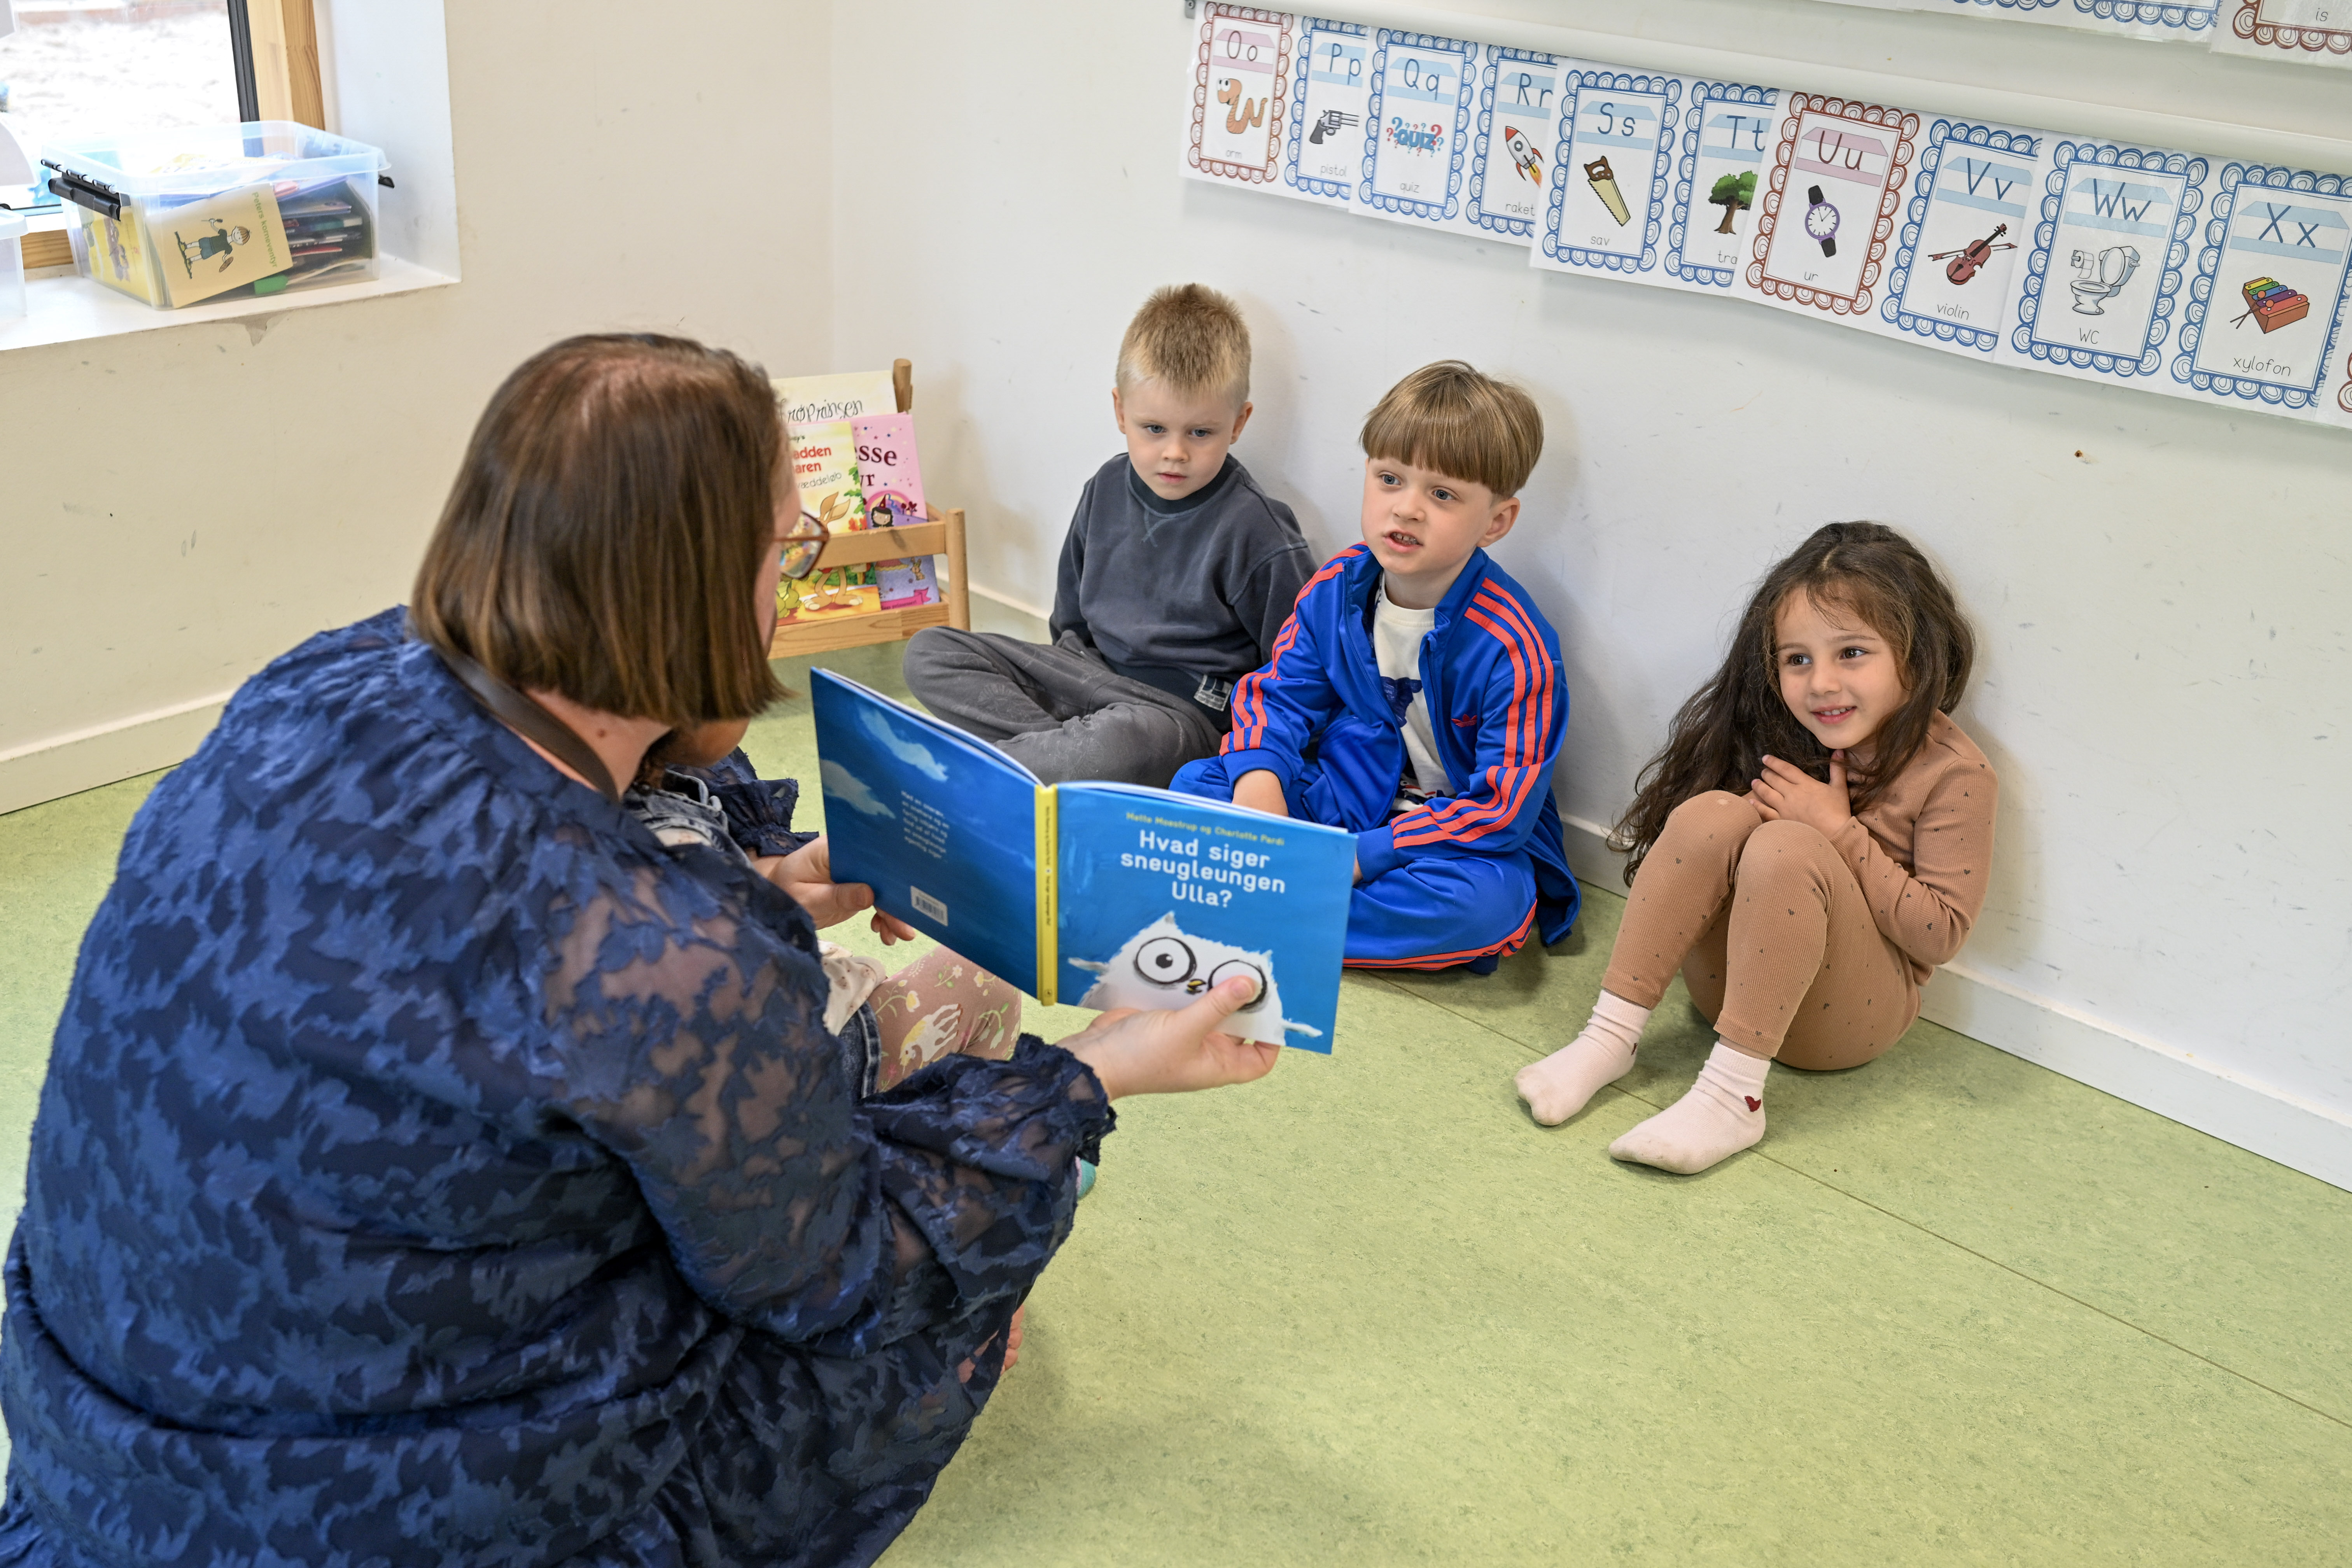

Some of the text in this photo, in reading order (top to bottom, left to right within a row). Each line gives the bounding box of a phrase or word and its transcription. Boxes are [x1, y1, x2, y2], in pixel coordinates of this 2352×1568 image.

[2316, 8, 2328, 22] is
[1393, 129, 1436, 150] QUIZ
[1320, 164, 1347, 177] pistol
[1400, 182, 1419, 194] quiz
[252, 192, 264, 219] Peters
[1505, 201, 1535, 216] raket
[1591, 236, 1610, 247] sav
[1804, 271, 1818, 282] ur
[1937, 303, 1969, 320] violin
[2079, 328, 2100, 345] WC
[2233, 355, 2291, 377] xylofon
[793, 446, 831, 459] adden
[855, 446, 897, 466] sse
[795, 462, 821, 473] aren
[1139, 829, 1270, 869] Hvad siger
[1120, 852, 1286, 894] sneugleungen
[1172, 880, 1233, 908] Ulla?
